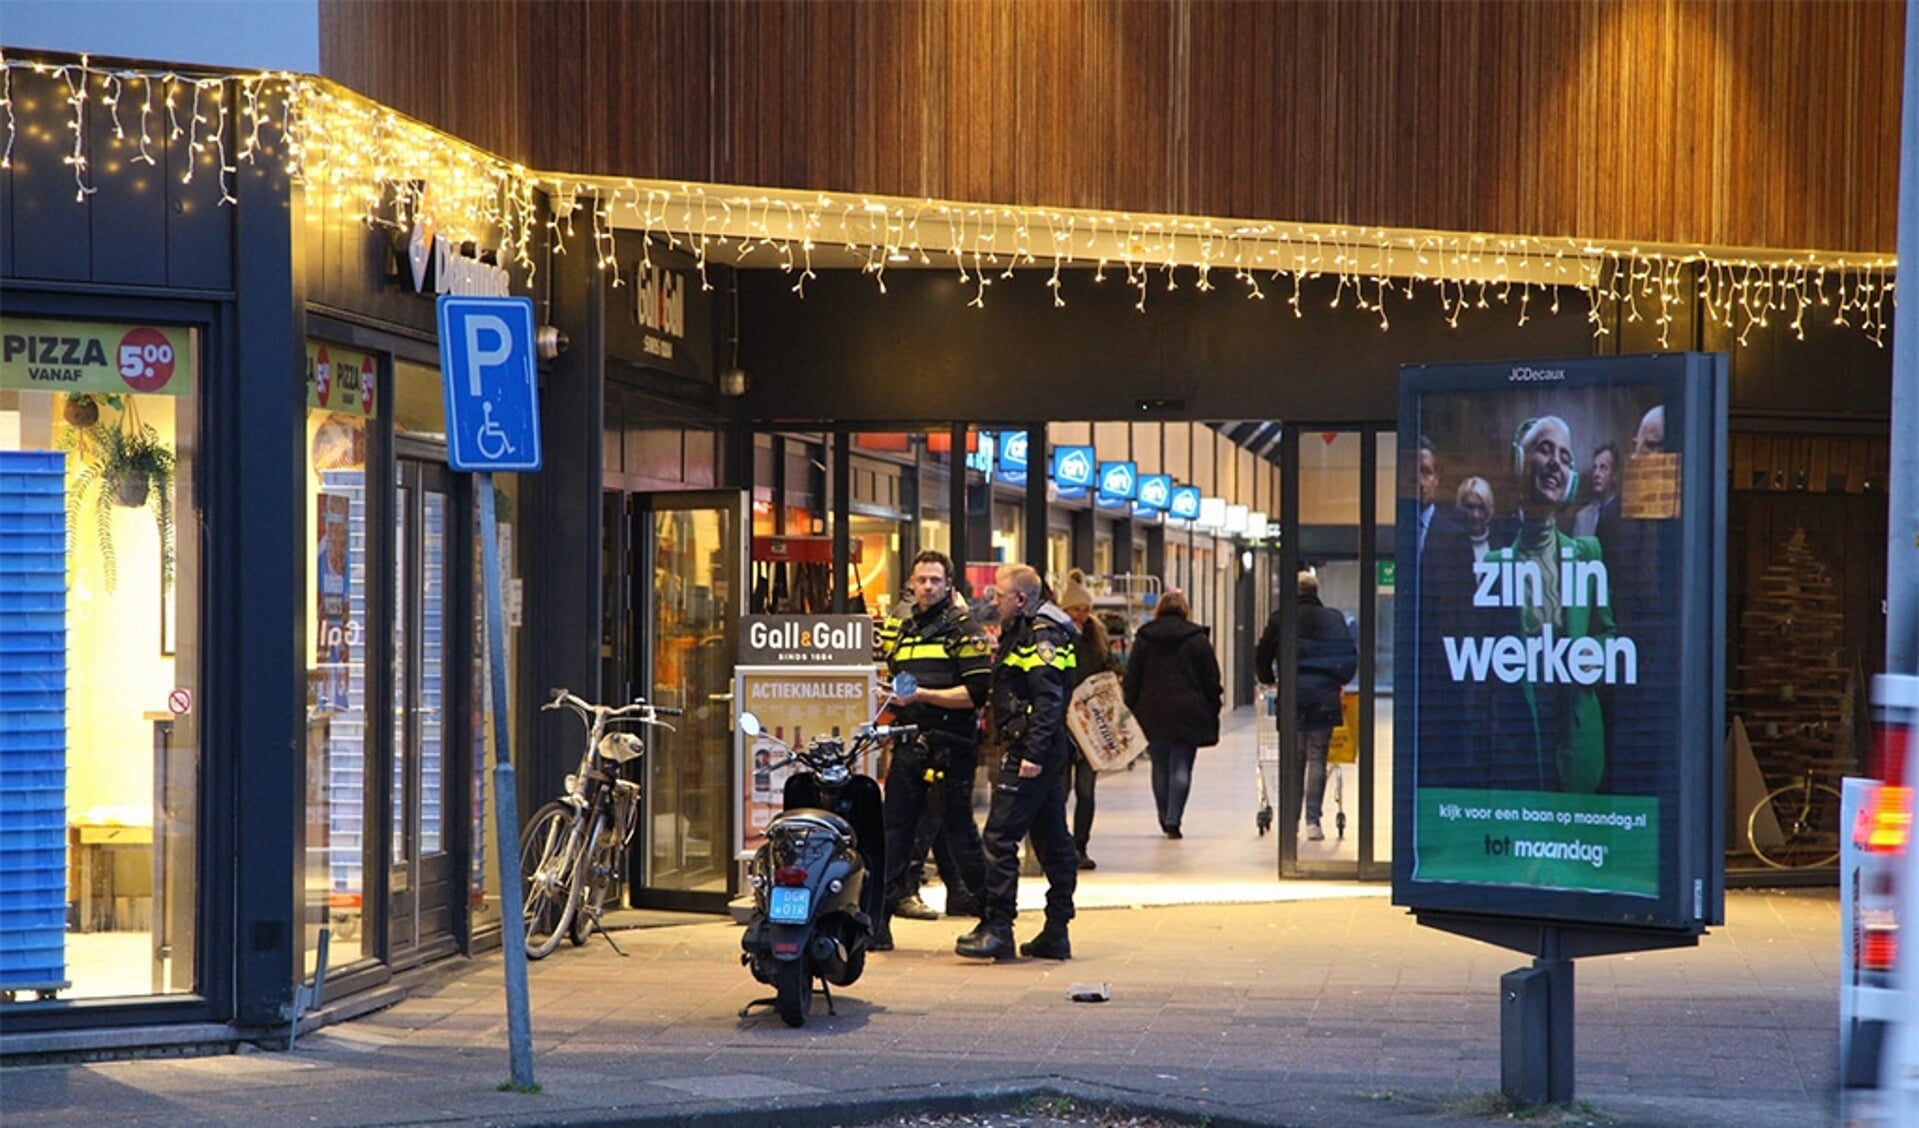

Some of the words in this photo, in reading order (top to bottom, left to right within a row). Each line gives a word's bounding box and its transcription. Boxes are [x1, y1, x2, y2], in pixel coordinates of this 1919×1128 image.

[3, 335, 108, 366] PIZZA
[464, 314, 512, 396] P
[28, 367, 82, 382] VANAF
[1509, 367, 1566, 381] JCDecaux
[1473, 547, 1543, 607] zin
[1561, 546, 1607, 607] in
[750, 621, 862, 649] Gall&Gall
[1442, 623, 1637, 685] werken
[752, 683, 862, 698] ACTIEKNALLERS
[1438, 804, 1462, 821] kijk
[1465, 807, 1491, 820] voor
[1494, 809, 1519, 821] een
[1522, 808, 1554, 822] baan
[1556, 812, 1572, 825] op
[1574, 812, 1647, 830] maandag.nl
[1484, 834, 1510, 856] tot
